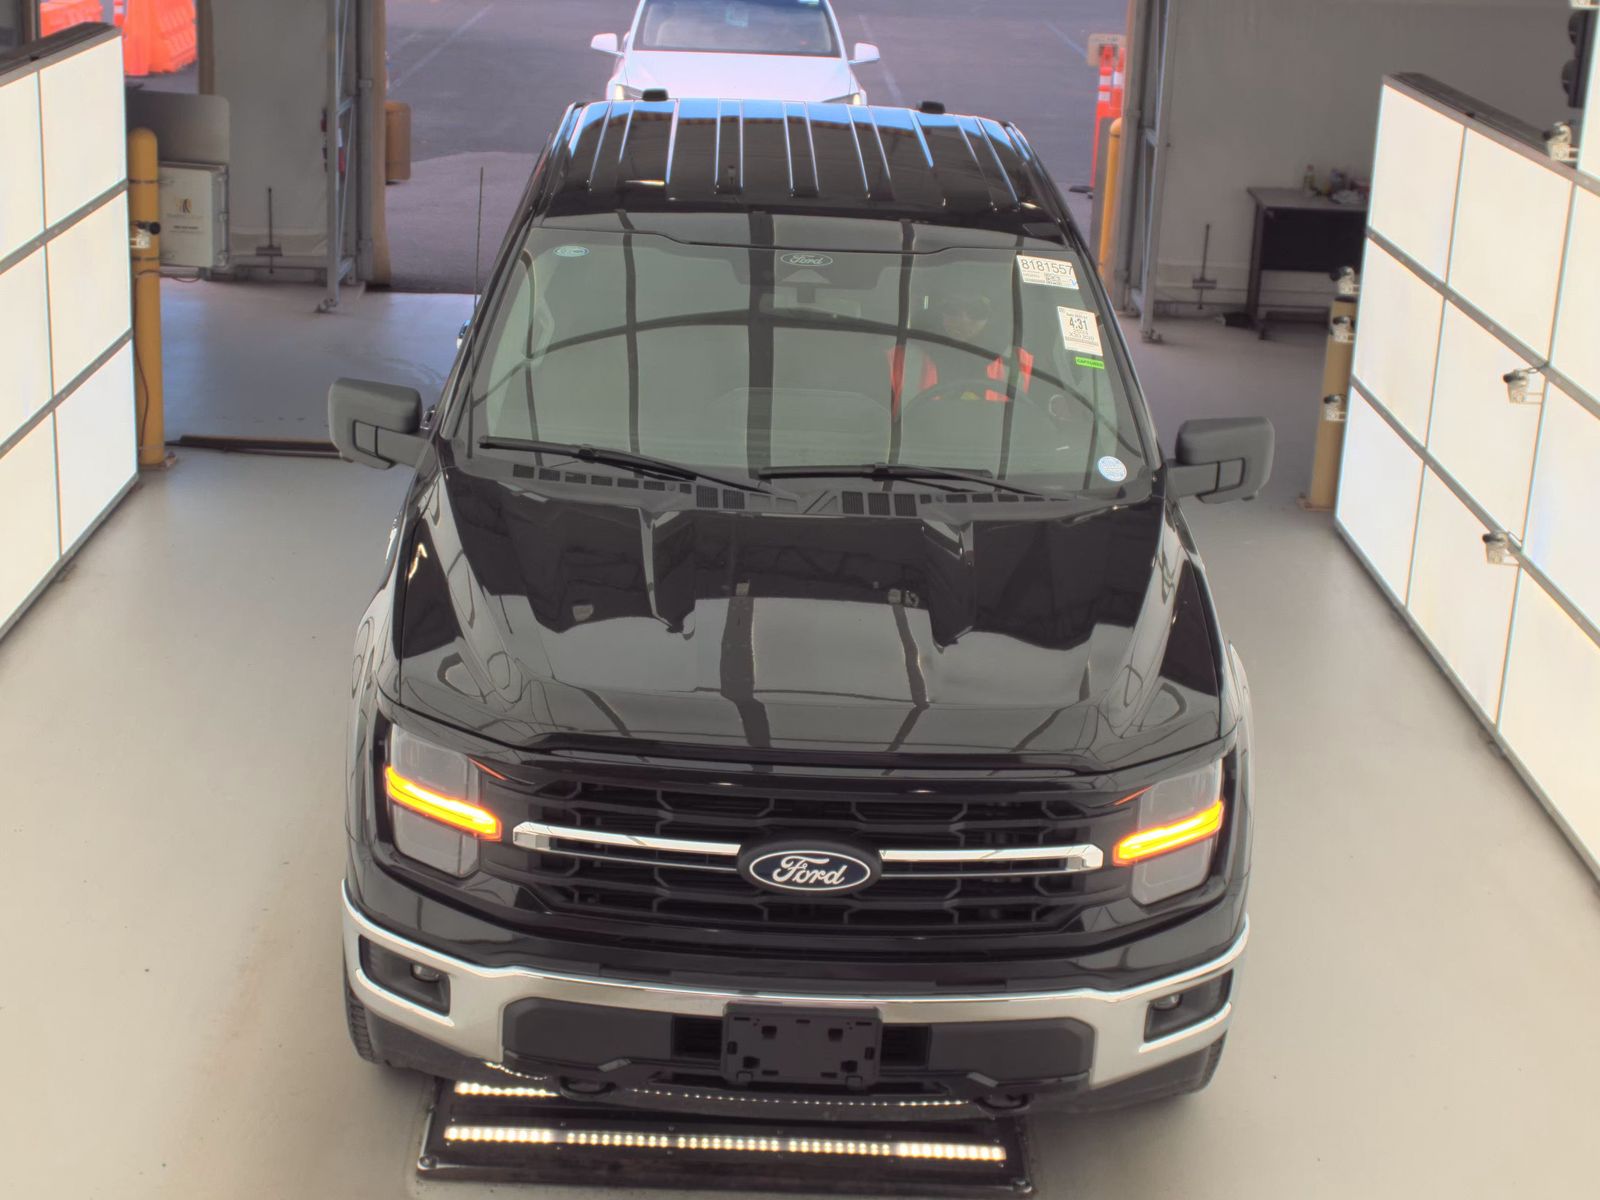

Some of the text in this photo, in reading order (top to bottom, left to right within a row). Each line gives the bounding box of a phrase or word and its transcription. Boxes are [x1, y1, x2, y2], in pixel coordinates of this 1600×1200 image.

[790, 255, 823, 264] Ford
[1021, 259, 1073, 275] 8181557
[1069, 317, 1088, 330] 4:31
[772, 855, 848, 885] Ford
